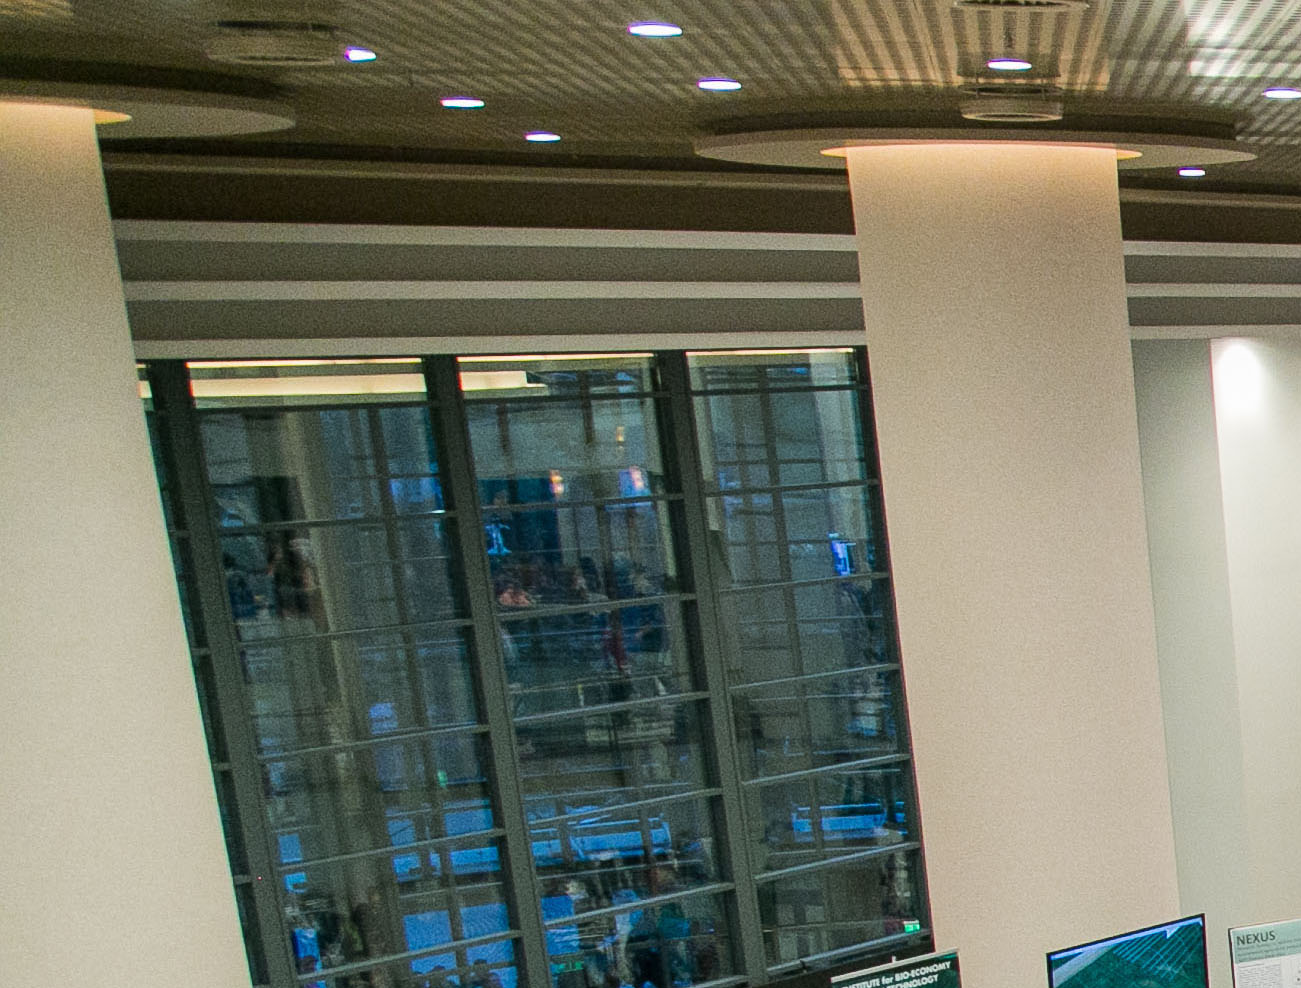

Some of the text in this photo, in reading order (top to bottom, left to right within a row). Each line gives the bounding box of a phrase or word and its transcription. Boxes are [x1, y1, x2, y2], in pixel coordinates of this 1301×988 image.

[1236, 930, 1276, 946] NEXUS
[881, 975, 893, 985] for
[894, 961, 951, 982] BIO-ECONOMY
